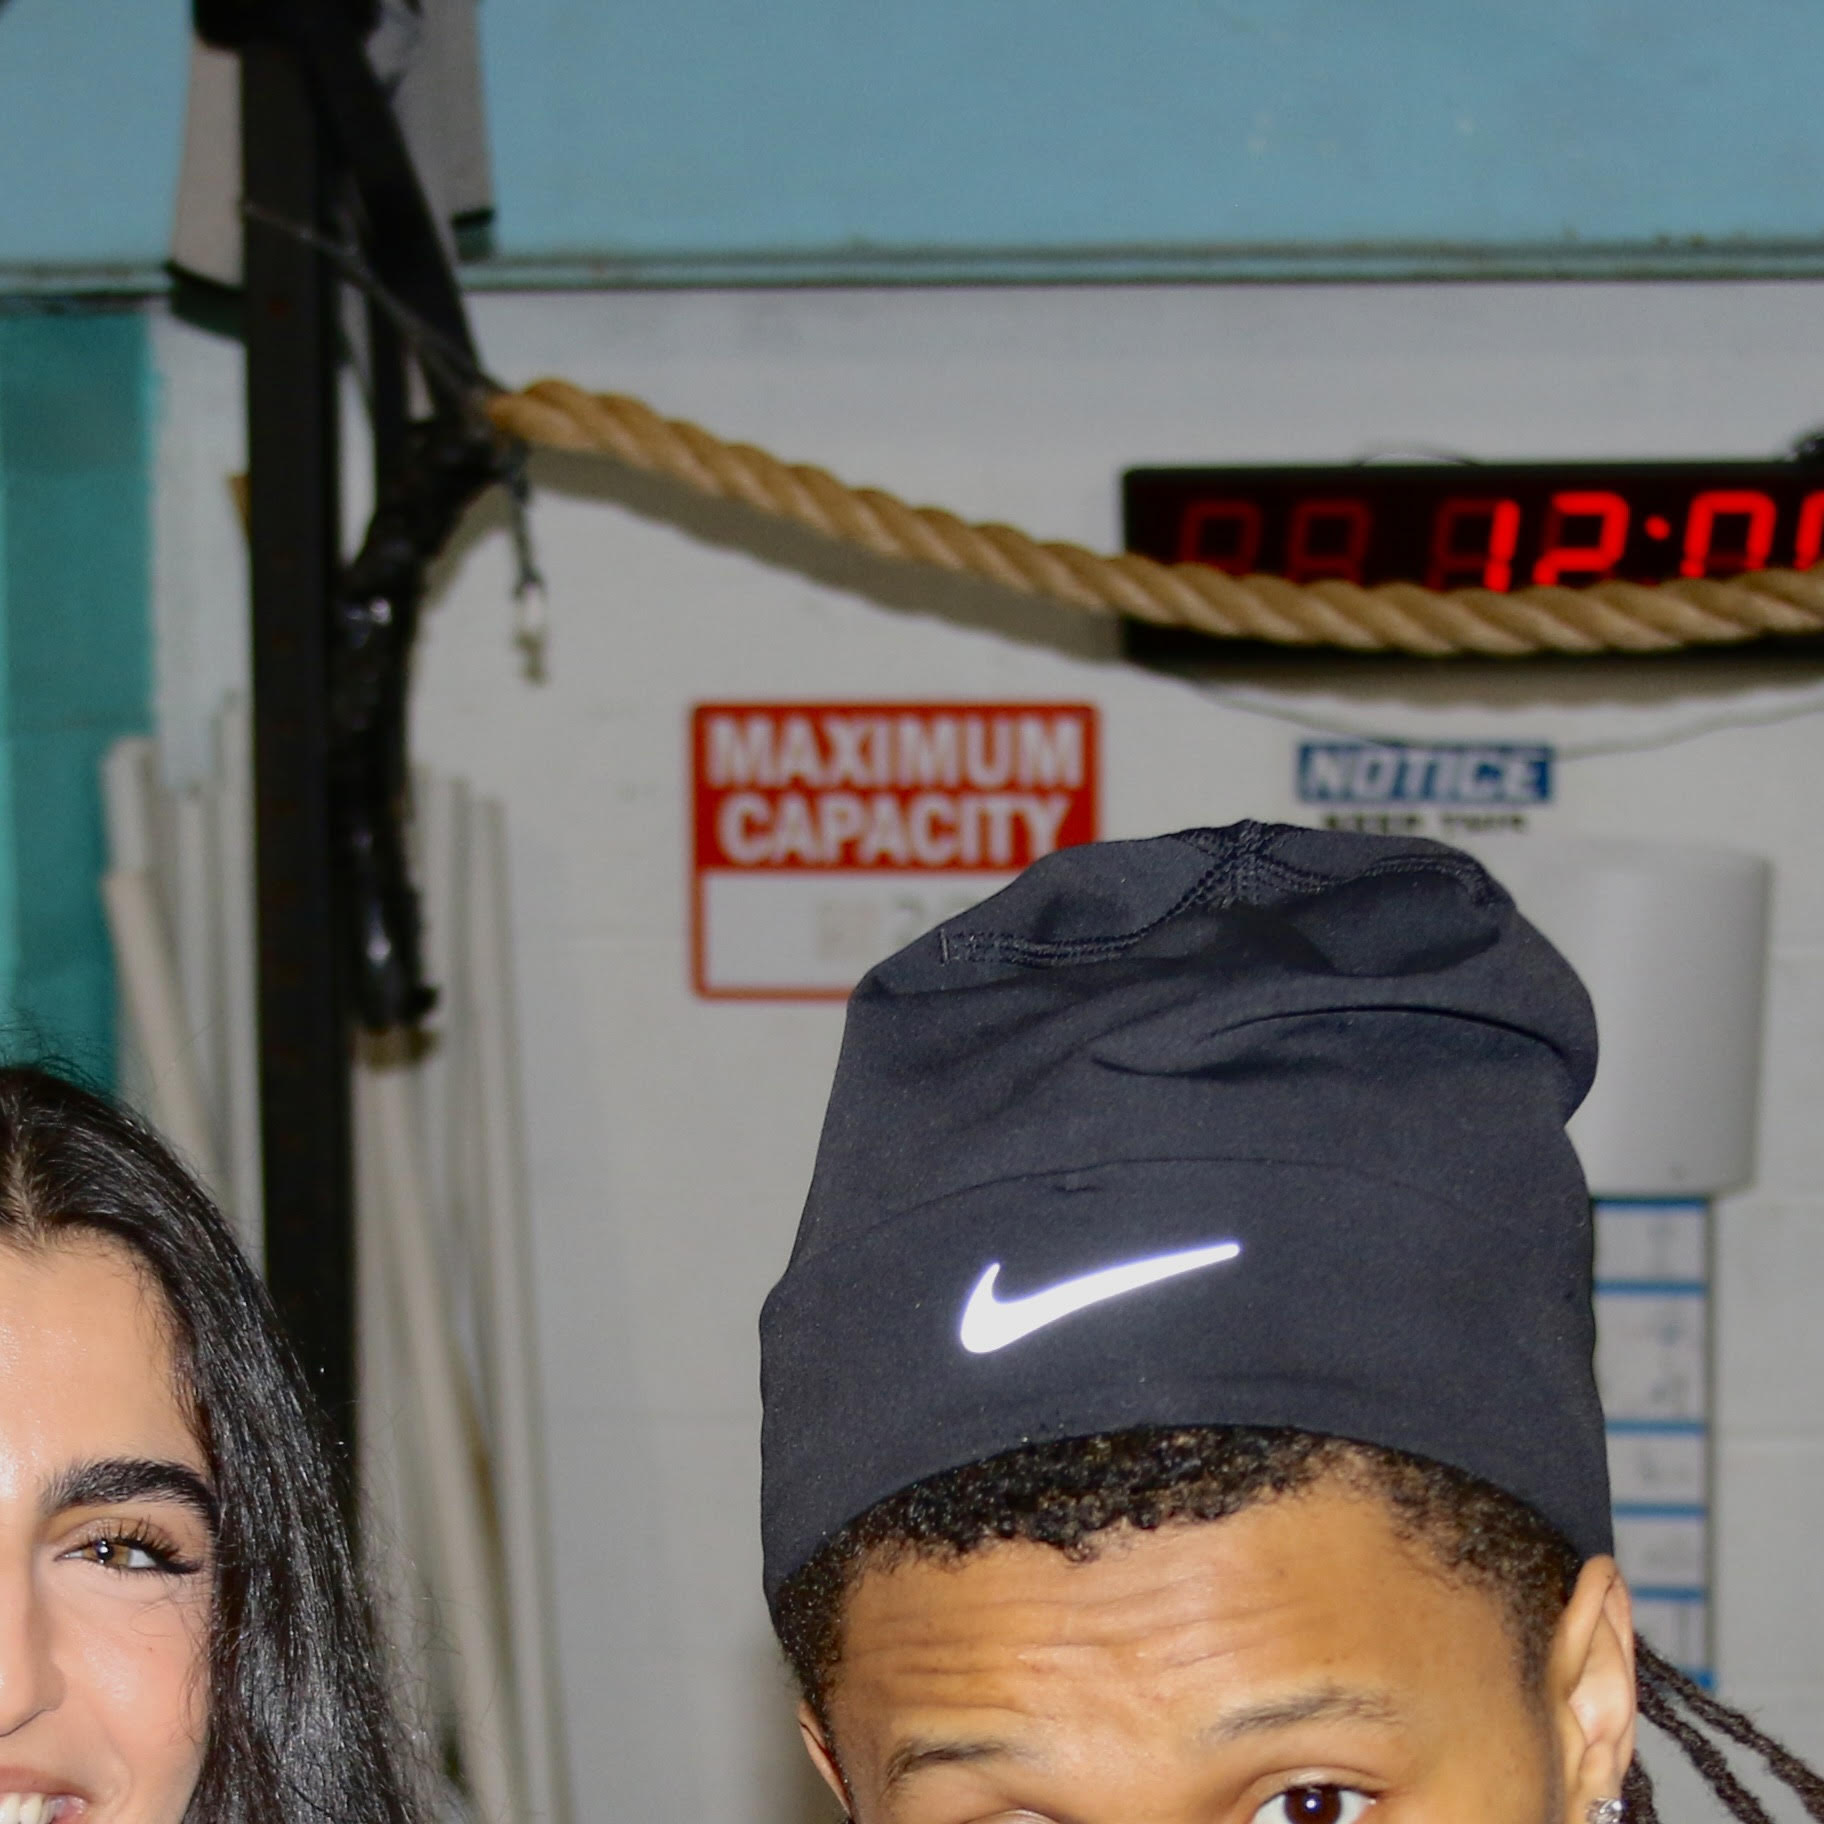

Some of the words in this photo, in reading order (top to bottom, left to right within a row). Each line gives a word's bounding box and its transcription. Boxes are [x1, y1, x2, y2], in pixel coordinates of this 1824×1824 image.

[706, 714, 1083, 791] MAXIMUM
[1306, 751, 1545, 800] NOTICE
[716, 792, 1073, 865] CAPACITY
